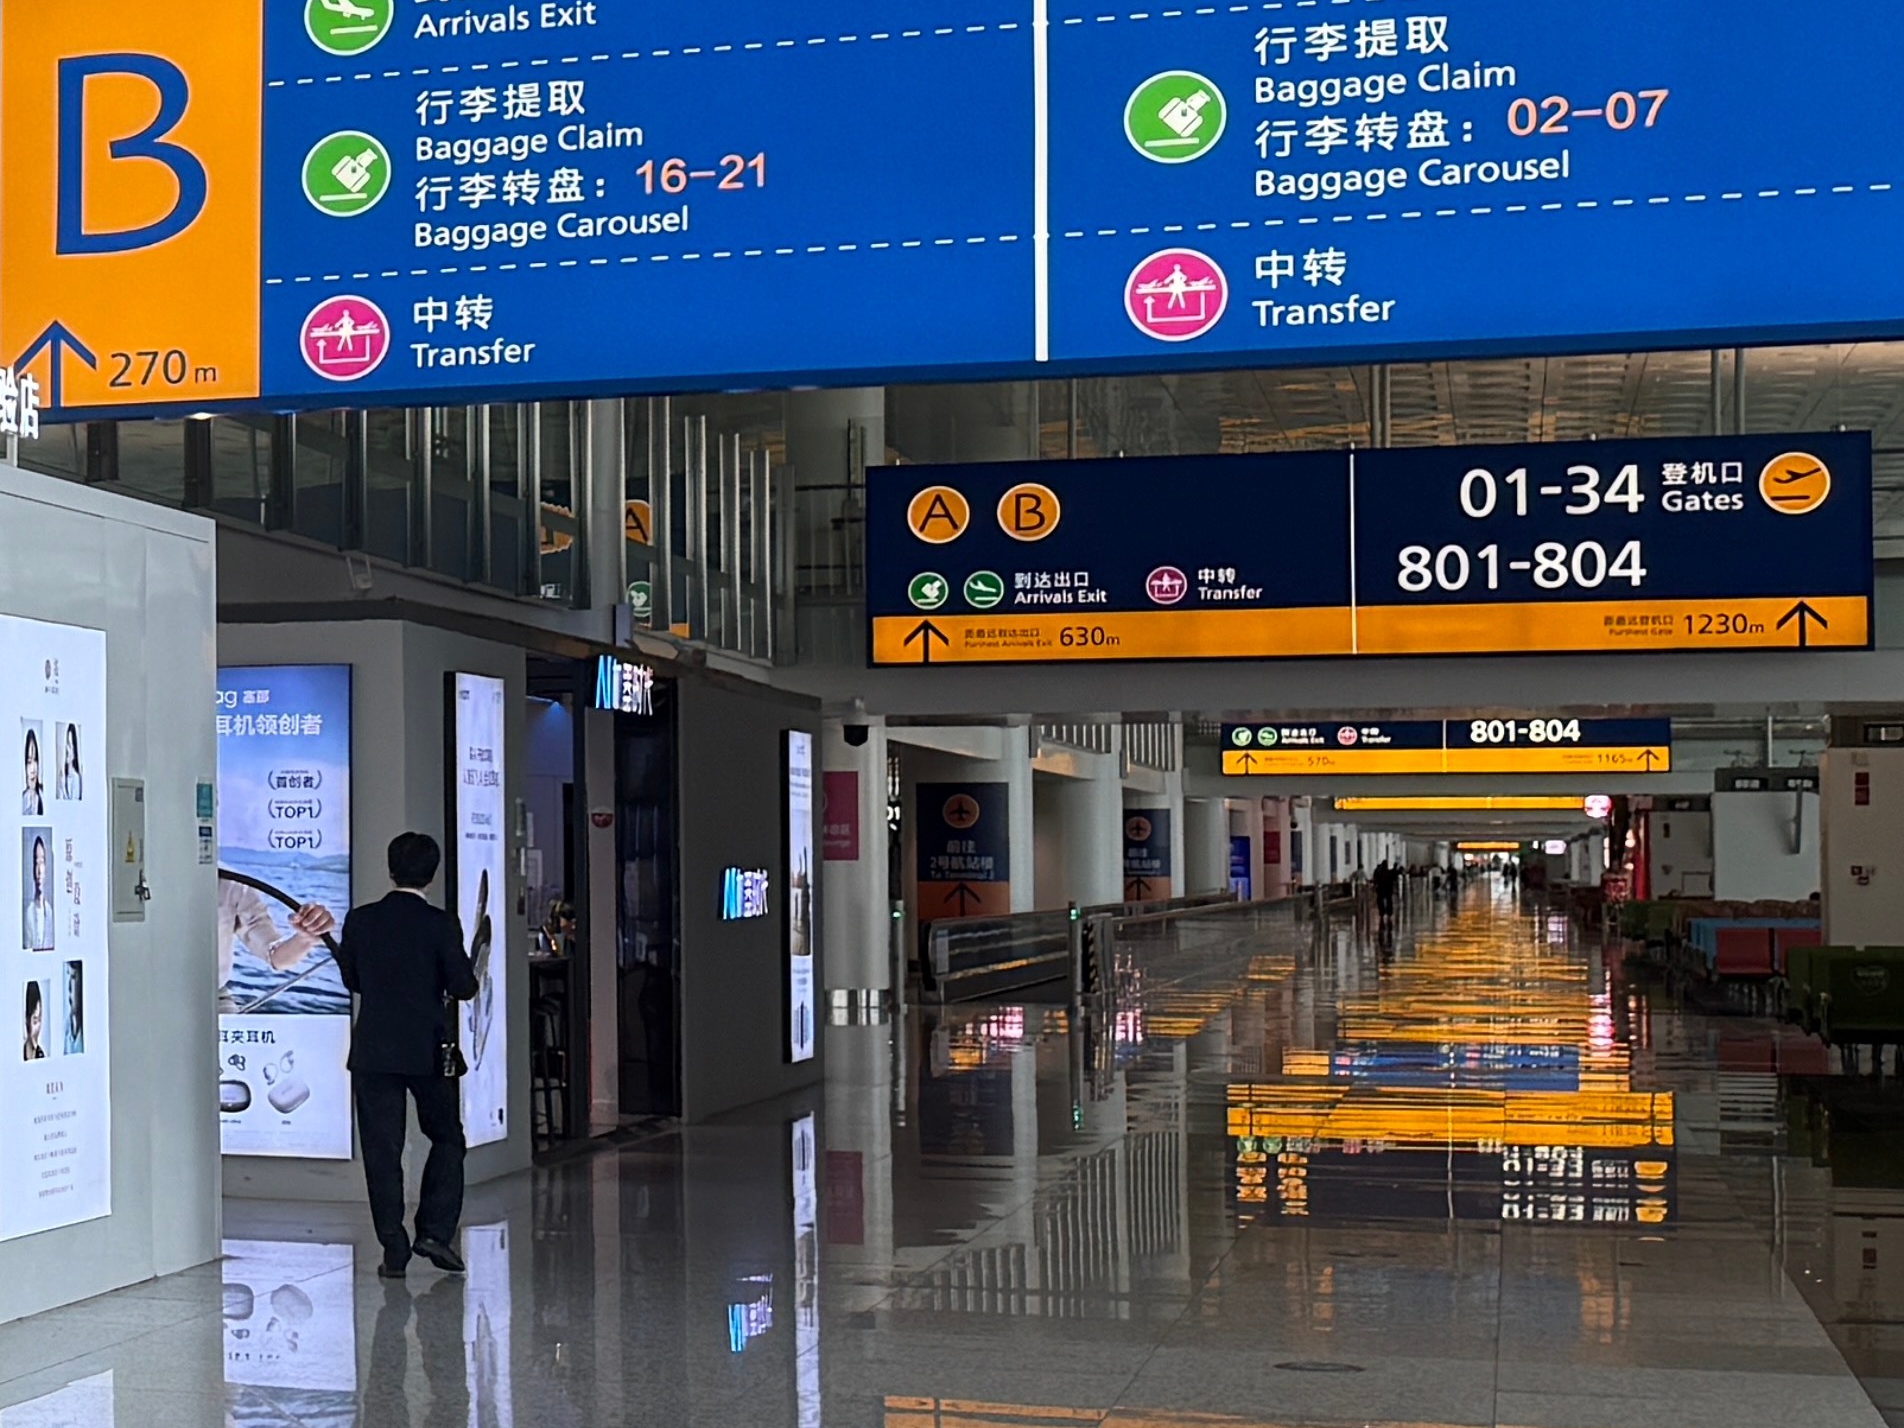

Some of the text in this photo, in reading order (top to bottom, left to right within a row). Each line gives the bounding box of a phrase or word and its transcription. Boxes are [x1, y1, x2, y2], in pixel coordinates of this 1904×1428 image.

[414, 0, 597, 38] Arrivals Exit
[1254, 15, 1450, 66] 行李提取
[415, 79, 586, 127] 行李提取
[1255, 61, 1517, 108] Baggage Claim
[56, 51, 209, 256] B
[415, 121, 643, 167] Baggage Claim
[1255, 109, 1474, 159] 行李转盘：
[414, 166, 606, 211] 行李转盘：
[1255, 149, 1570, 201] Baggage Carousel
[413, 206, 689, 253] Baggage Carousel
[1254, 246, 1347, 289] 中转
[412, 292, 494, 333] 中转
[1252, 293, 1396, 328] Transfer
[410, 337, 535, 369] Transfer
[1459, 463, 1645, 518] 01-34
[1661, 461, 1744, 487] 登机口
[919, 493, 959, 533] A
[1014, 492, 1046, 532] B
[1661, 490, 1744, 513] Gates
[1013, 570, 1090, 589] 到达出口
[1197, 567, 1237, 584] 中转
[1397, 540, 1647, 592] 801-804
[1013, 587, 1108, 606] Arrivals Exit
[1197, 584, 1263, 601] Transfer
[1059, 625, 1121, 648] 630m
[1683, 613, 1765, 635] 1230m
[1470, 719, 1582, 743] 801-804
[275, 805, 315, 819] TOP1
[275, 836, 315, 850] TOP1
